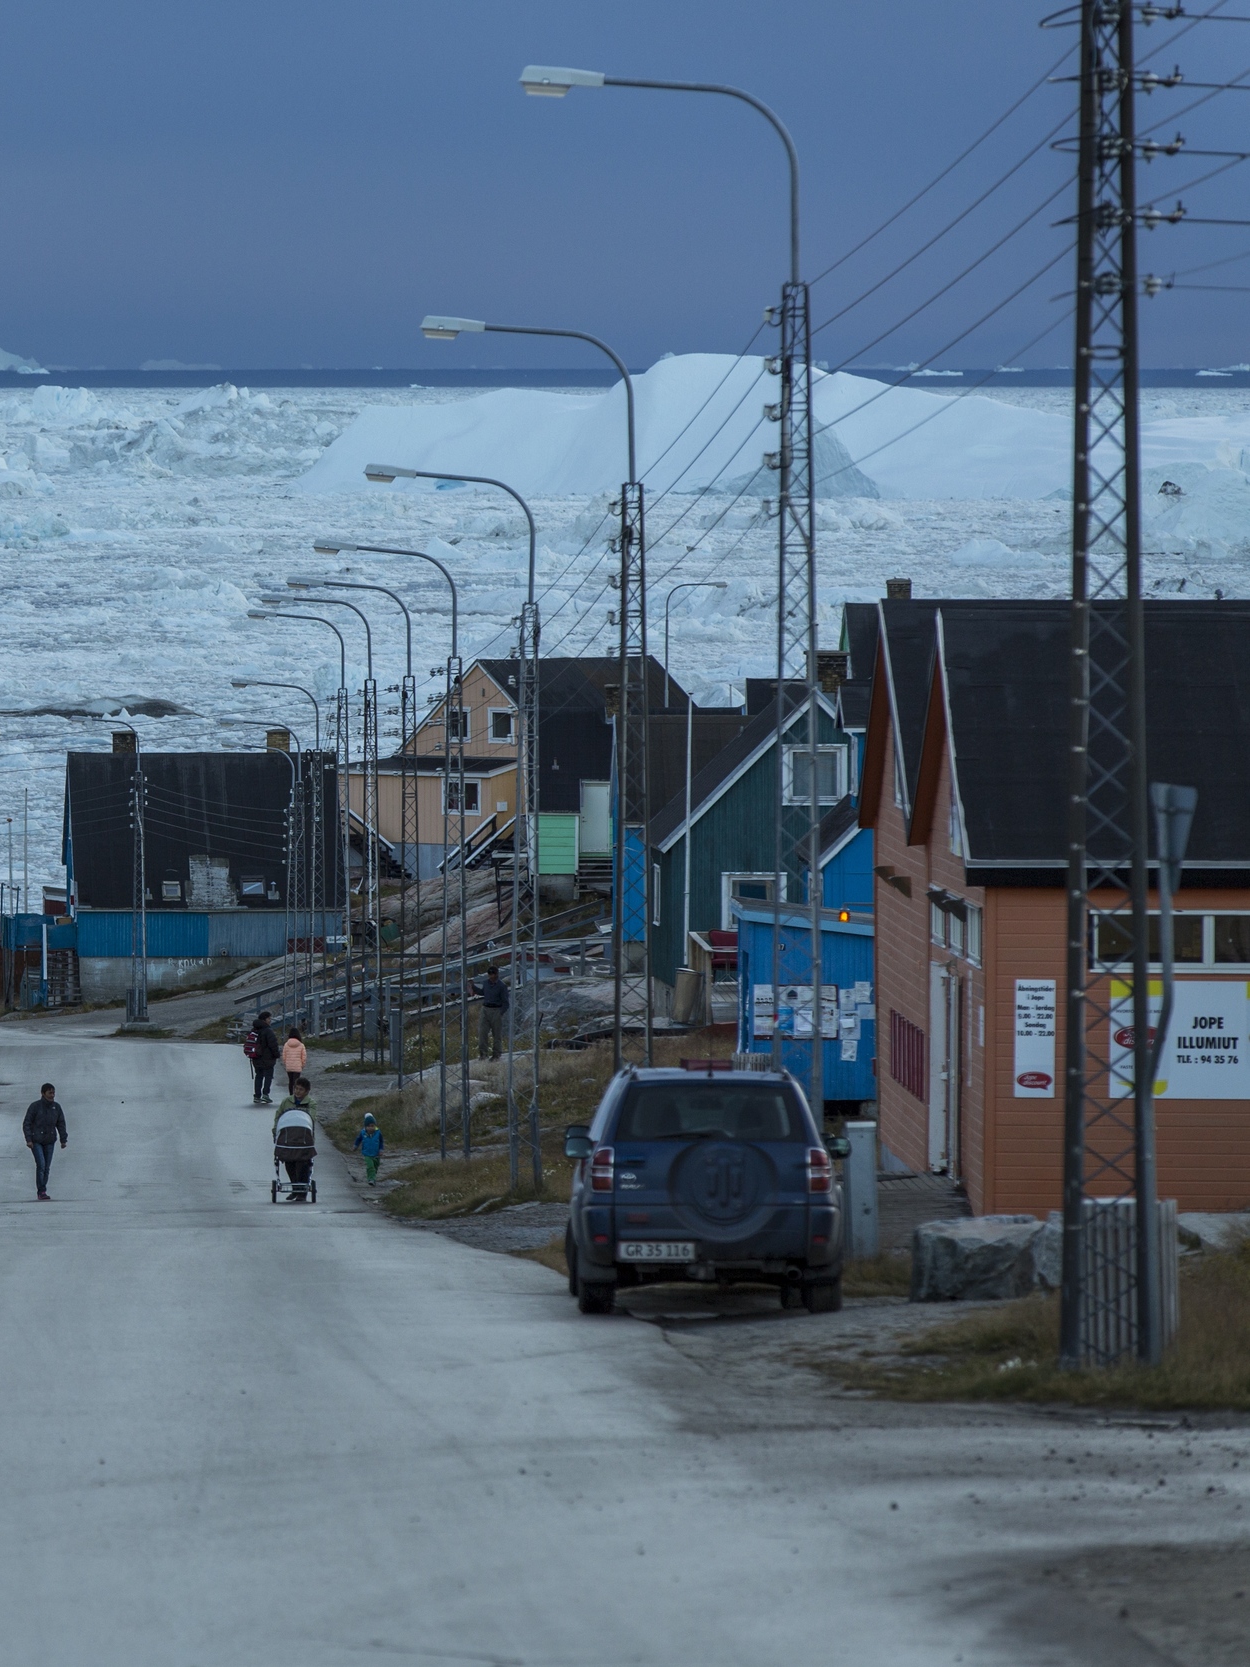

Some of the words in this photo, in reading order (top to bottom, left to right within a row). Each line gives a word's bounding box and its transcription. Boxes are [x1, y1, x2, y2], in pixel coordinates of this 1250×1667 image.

[1192, 1016, 1224, 1029] JOPE
[1177, 1036, 1239, 1049] ILLUMIUT
[1200, 1055, 1212, 1064] 94
[1214, 1055, 1225, 1064] 35
[1228, 1055, 1239, 1064] 76
[626, 1244, 643, 1257] GR
[646, 1244, 662, 1257] 35
[667, 1244, 690, 1257] 116
